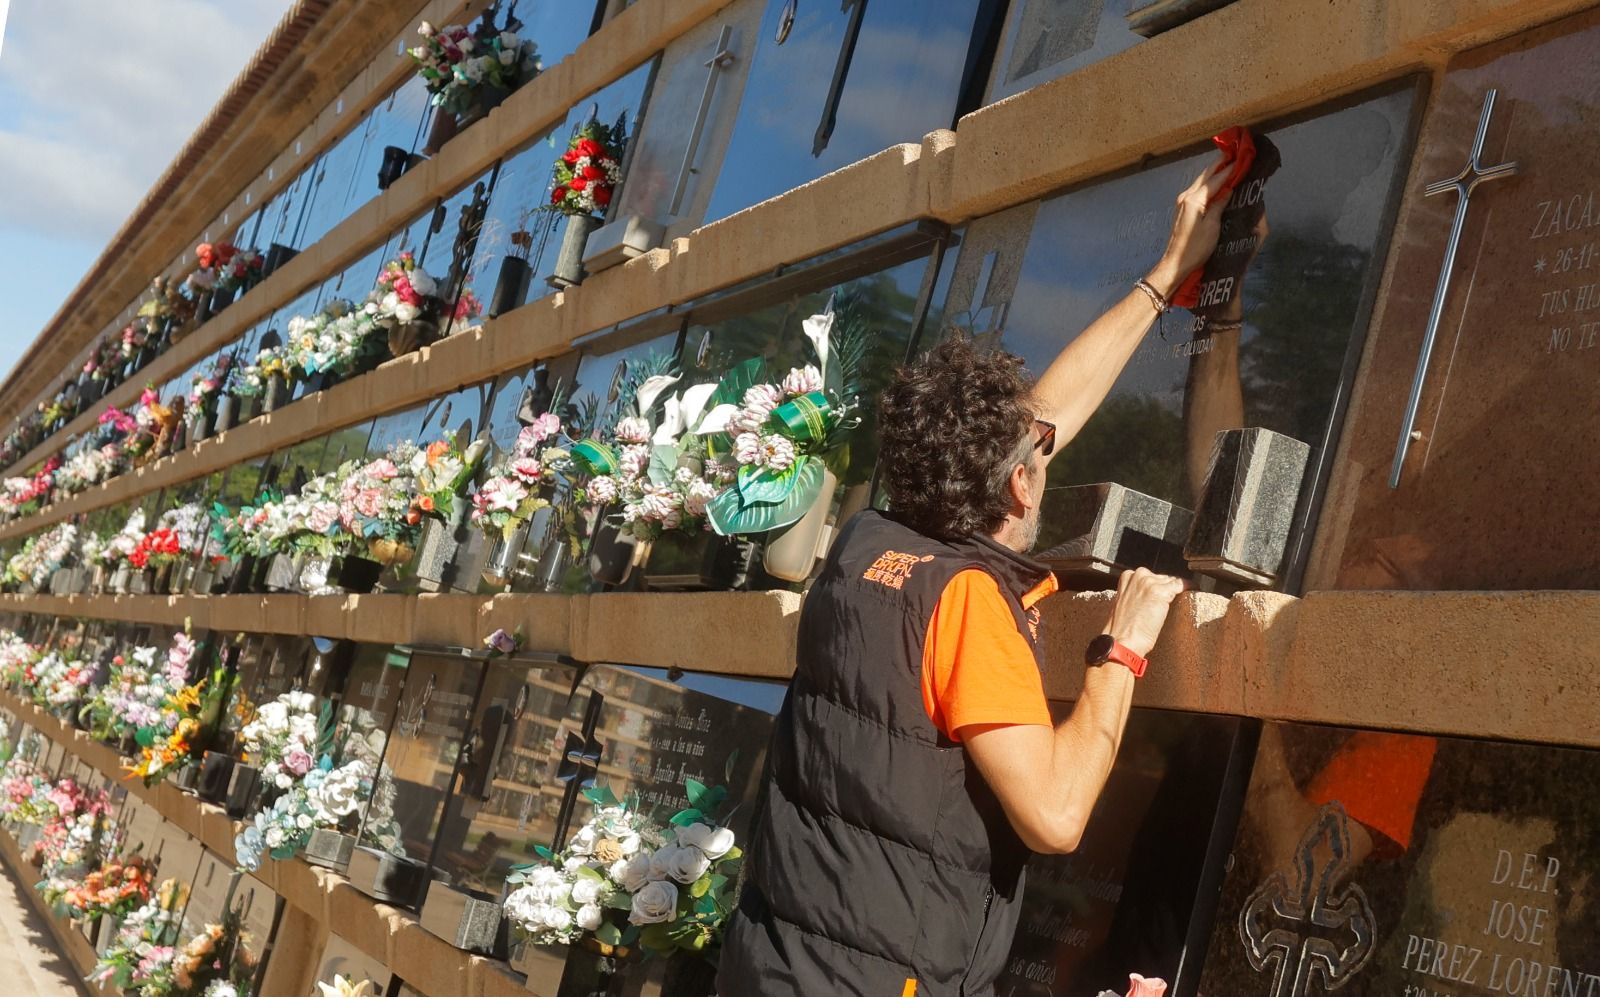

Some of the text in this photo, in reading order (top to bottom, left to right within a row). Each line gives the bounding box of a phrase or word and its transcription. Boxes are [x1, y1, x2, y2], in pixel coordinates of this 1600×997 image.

[1530, 191, 1600, 239] ZACA
[1538, 289, 1571, 319] TUS
[1171, 343, 1183, 359] TE
[1183, 336, 1217, 357] OLVIDAN
[1547, 326, 1571, 354] NO
[1490, 849, 1560, 896] D.E.P.
[1483, 899, 1548, 946] JOSE
[1025, 959, 1057, 985] años
[1401, 934, 1483, 984] PEREZ
